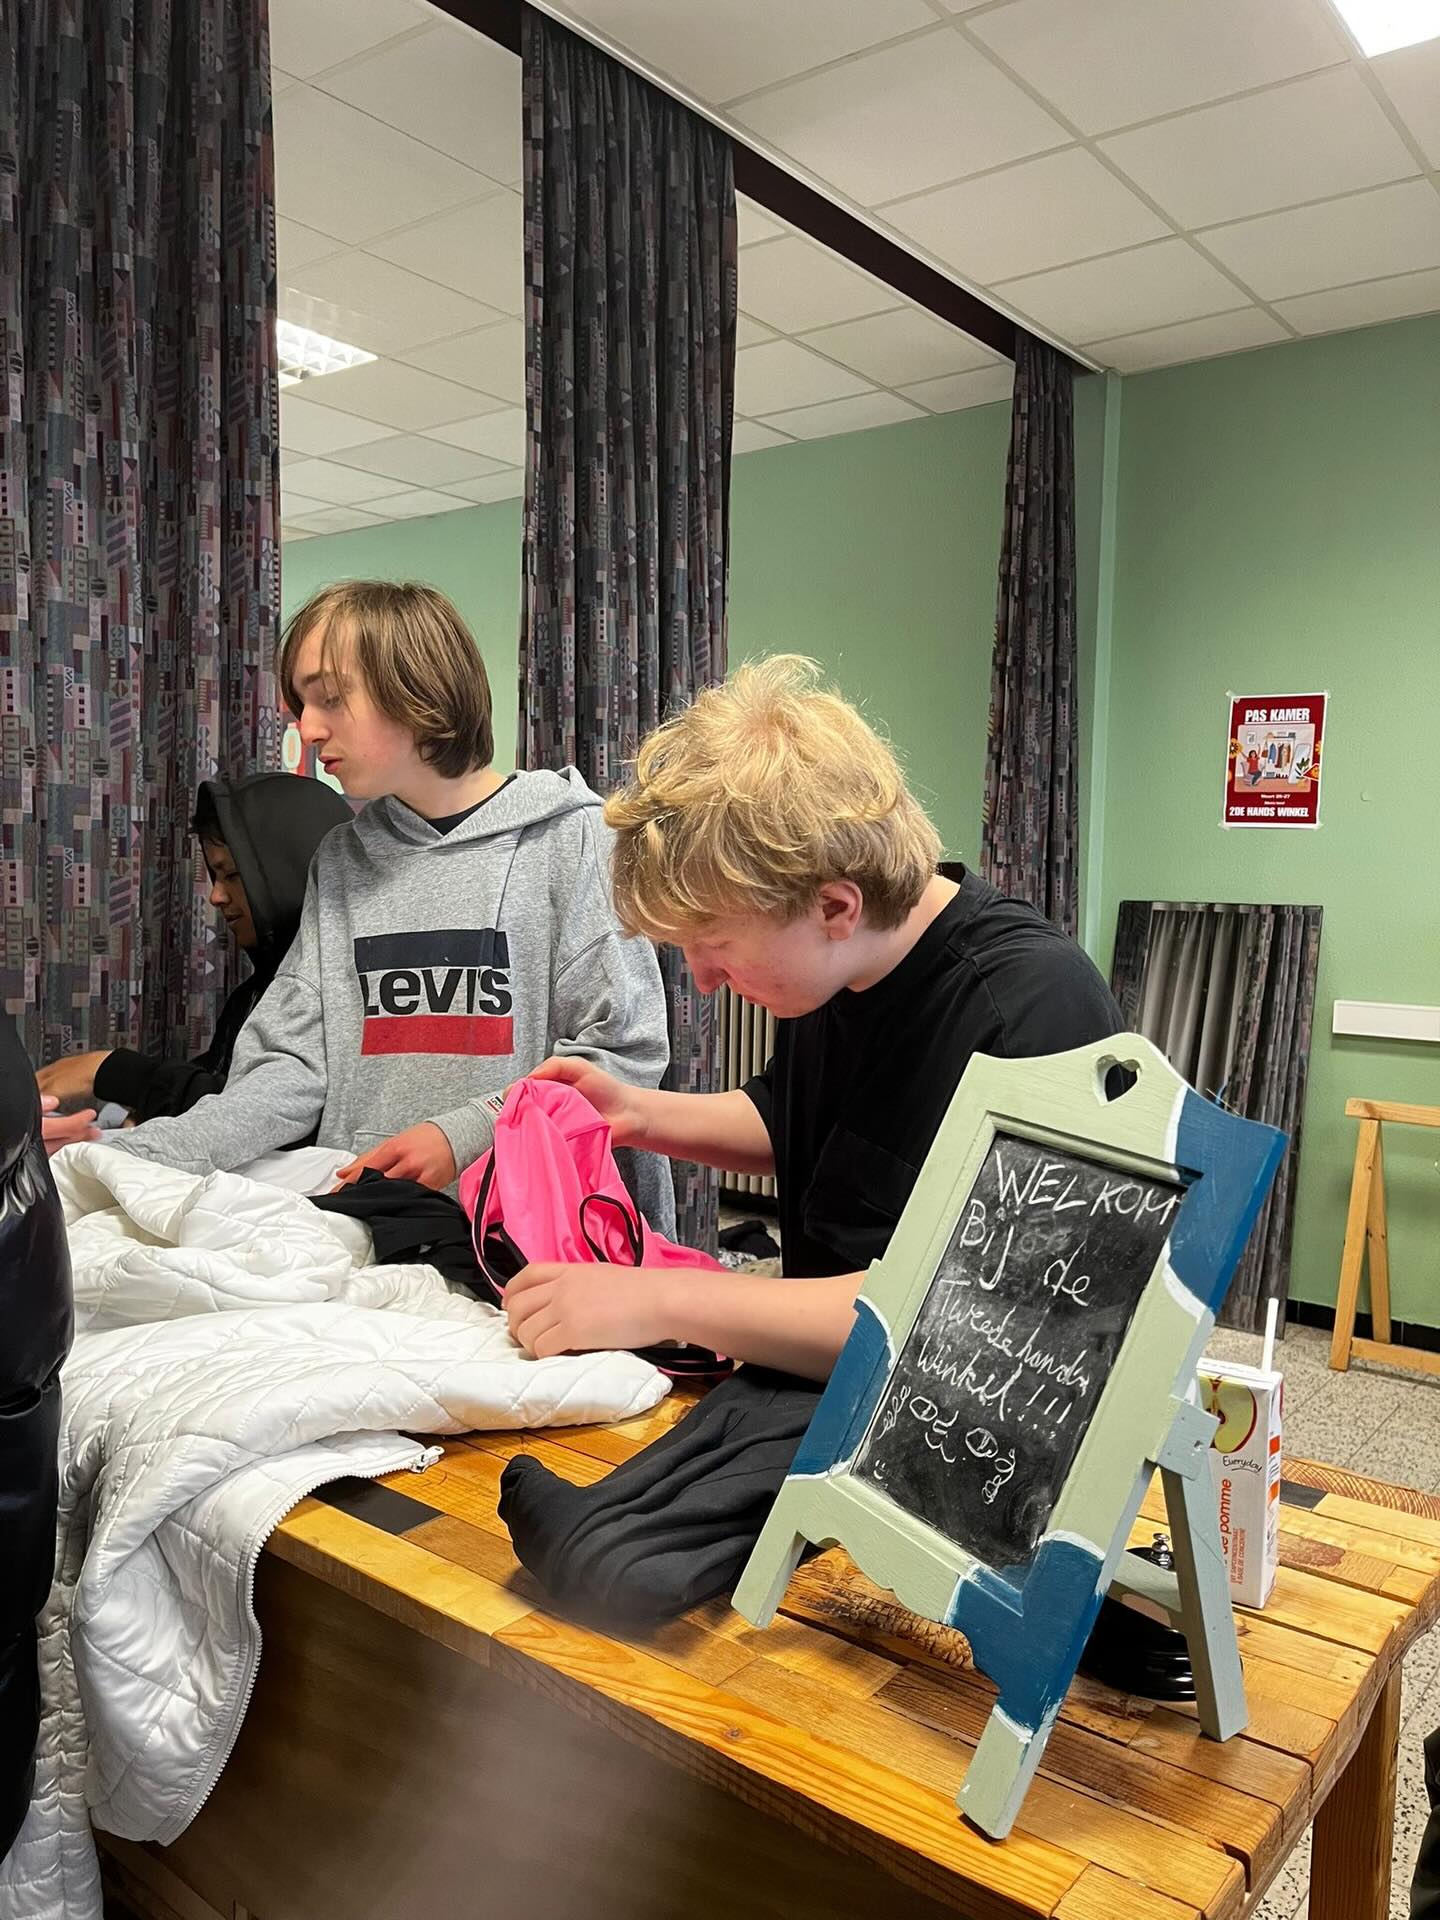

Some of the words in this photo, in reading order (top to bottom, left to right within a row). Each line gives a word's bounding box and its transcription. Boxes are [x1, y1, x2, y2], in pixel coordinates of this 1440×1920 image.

[1245, 709, 1267, 722] PAS
[1270, 708, 1310, 721] KAMER
[1229, 807, 1245, 817] 2DE
[1247, 807, 1275, 817] HANDS
[1277, 807, 1309, 817] WINKEL
[995, 1149, 1180, 1225] WELKOM
[1043, 1239, 1091, 1307] de
[1222, 1455, 1263, 1473] Everyday
[1219, 1478, 1232, 1535] pomme
